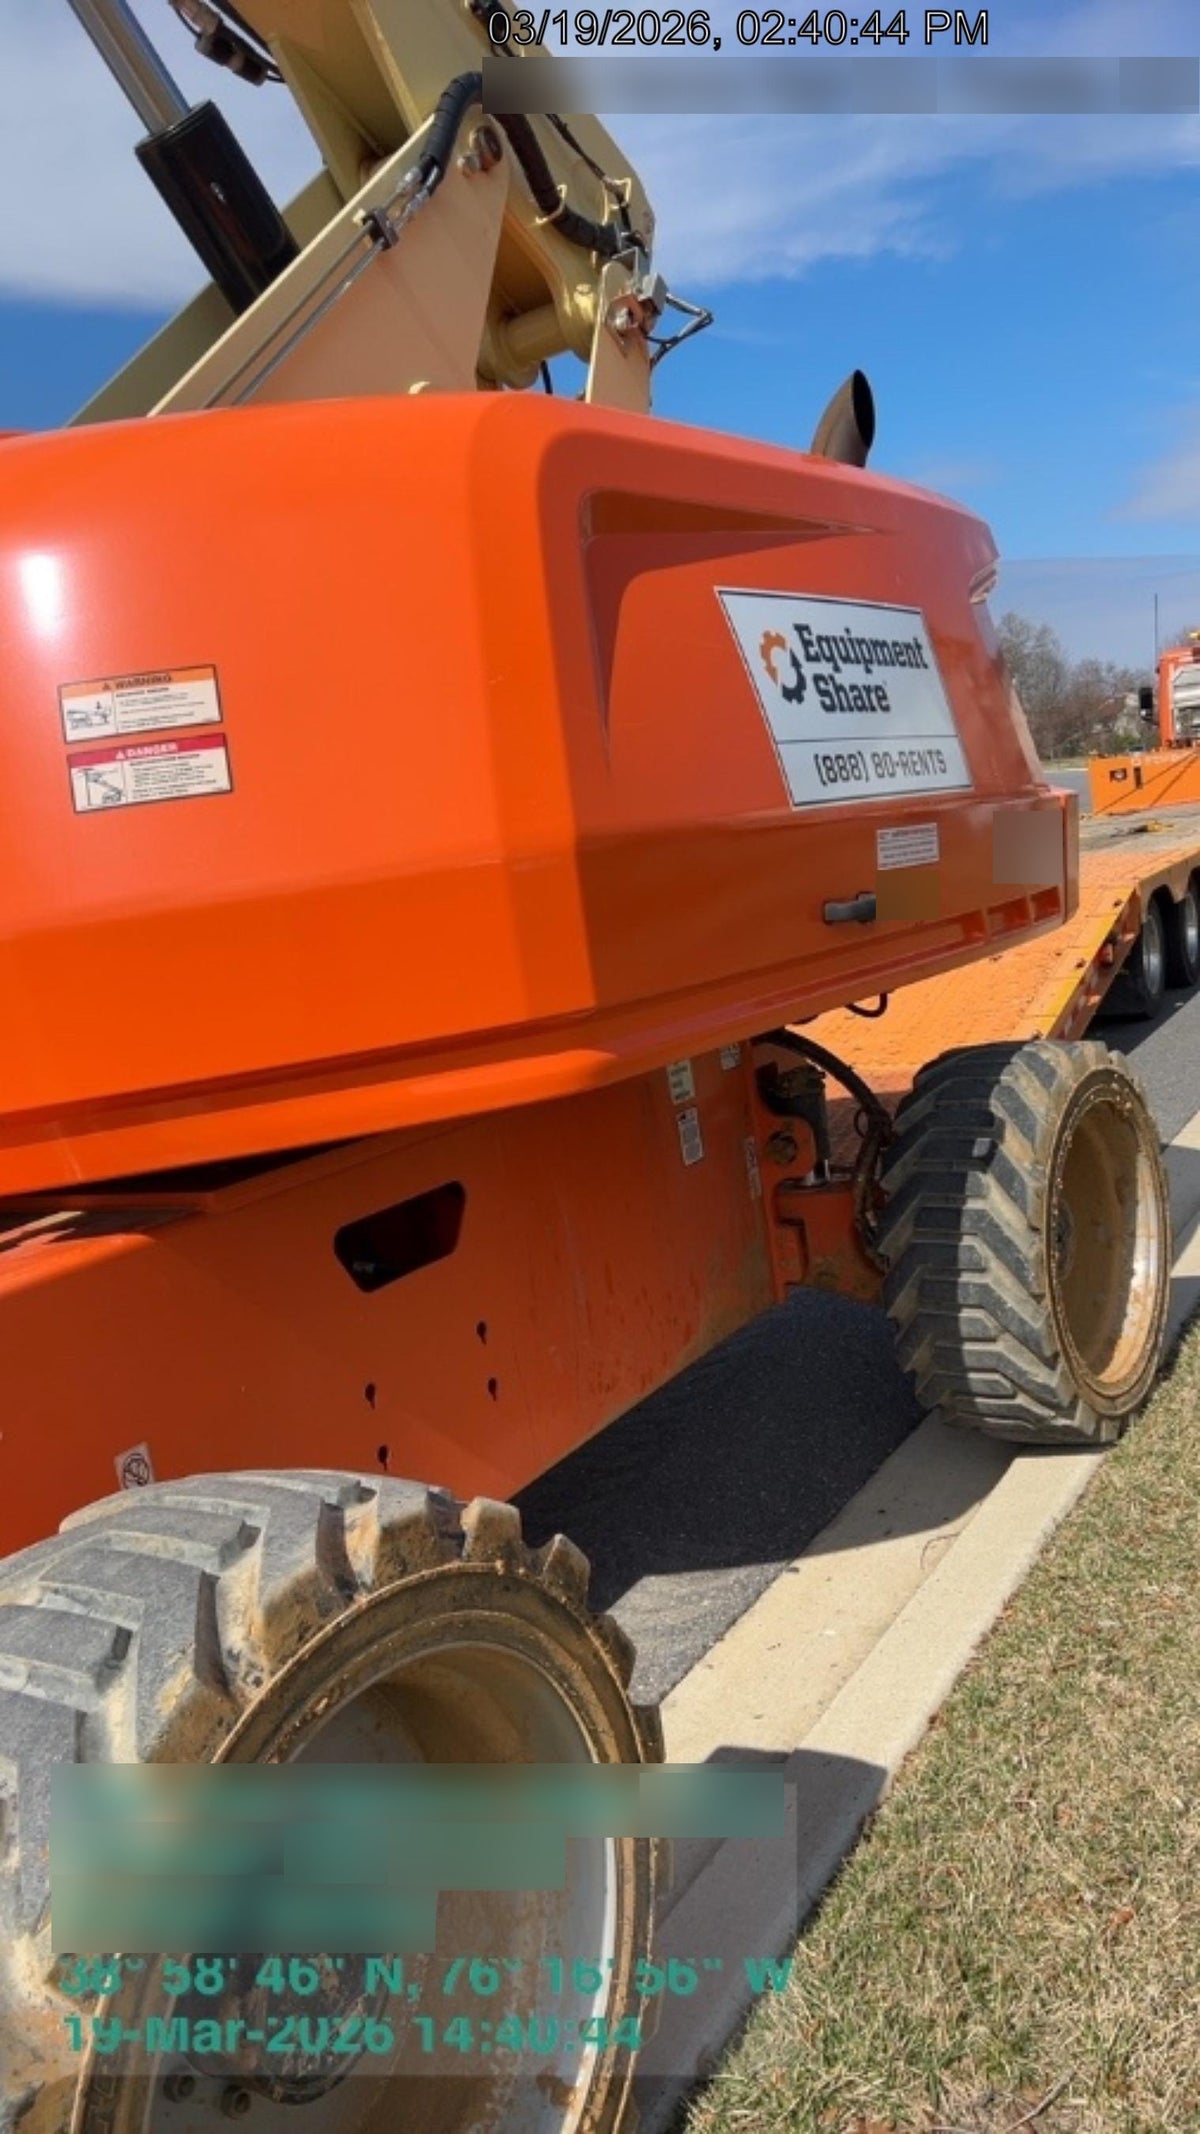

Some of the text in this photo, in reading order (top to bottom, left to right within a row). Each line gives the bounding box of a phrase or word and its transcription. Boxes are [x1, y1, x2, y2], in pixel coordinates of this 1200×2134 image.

[793, 623, 928, 673] Equipment
[812, 673, 890, 713] Share
[126, 742, 178, 758] DANGER
[814, 749, 947, 786] (888) 80-RENTS
